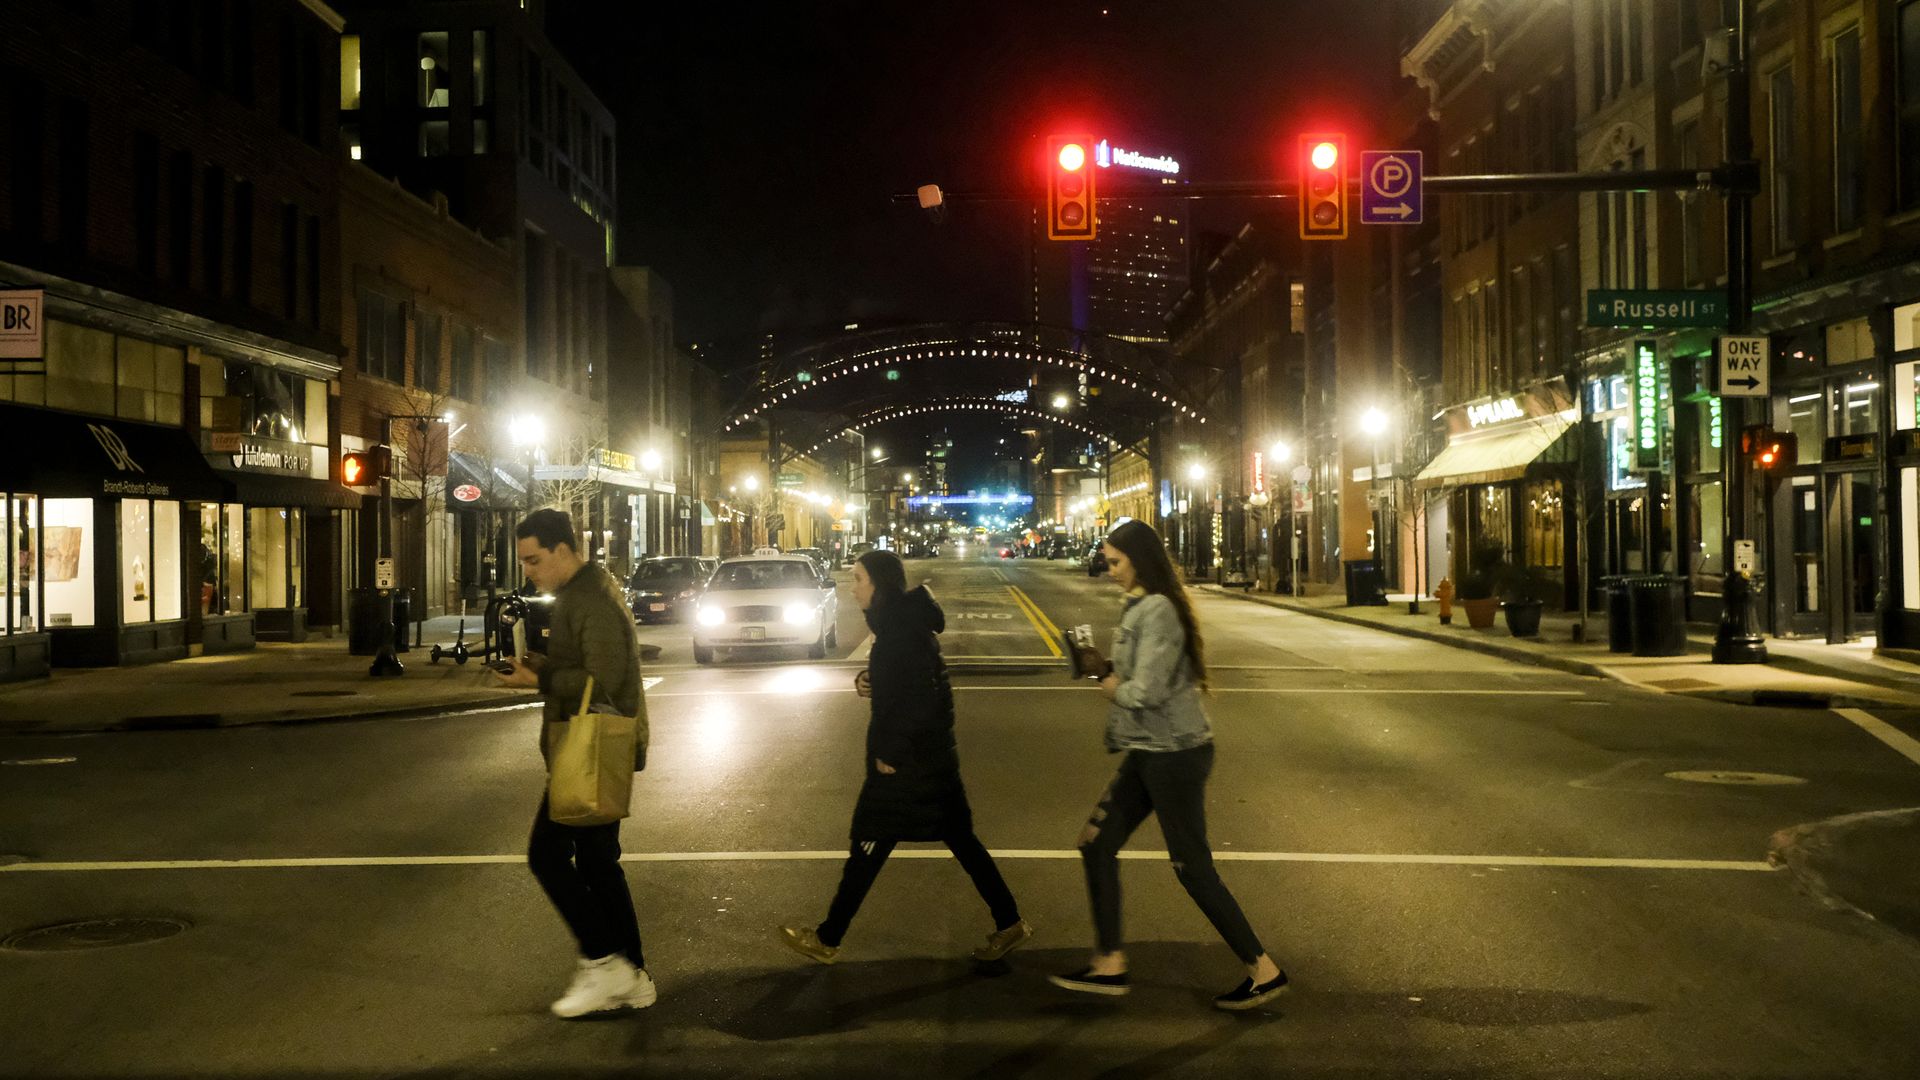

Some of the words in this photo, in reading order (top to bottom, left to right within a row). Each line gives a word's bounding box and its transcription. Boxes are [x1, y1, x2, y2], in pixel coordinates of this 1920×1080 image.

[1113, 147, 1179, 174] Nationwide
[1383, 165, 1404, 190] P
[4, 304, 31, 330] BR
[1598, 303, 1607, 313] W
[1613, 299, 1695, 318] Russell
[1702, 303, 1715, 313] ST
[1728, 340, 1760, 355] ONE
[1727, 357, 1761, 371] WAY
[1638, 346, 1657, 449] LEMONGRASS
[86, 423, 146, 474] BR
[244, 443, 281, 468] lululemon
[283, 454, 298, 470] POP
[299, 457, 309, 470] UP
[146, 482, 169, 496] Galleries
